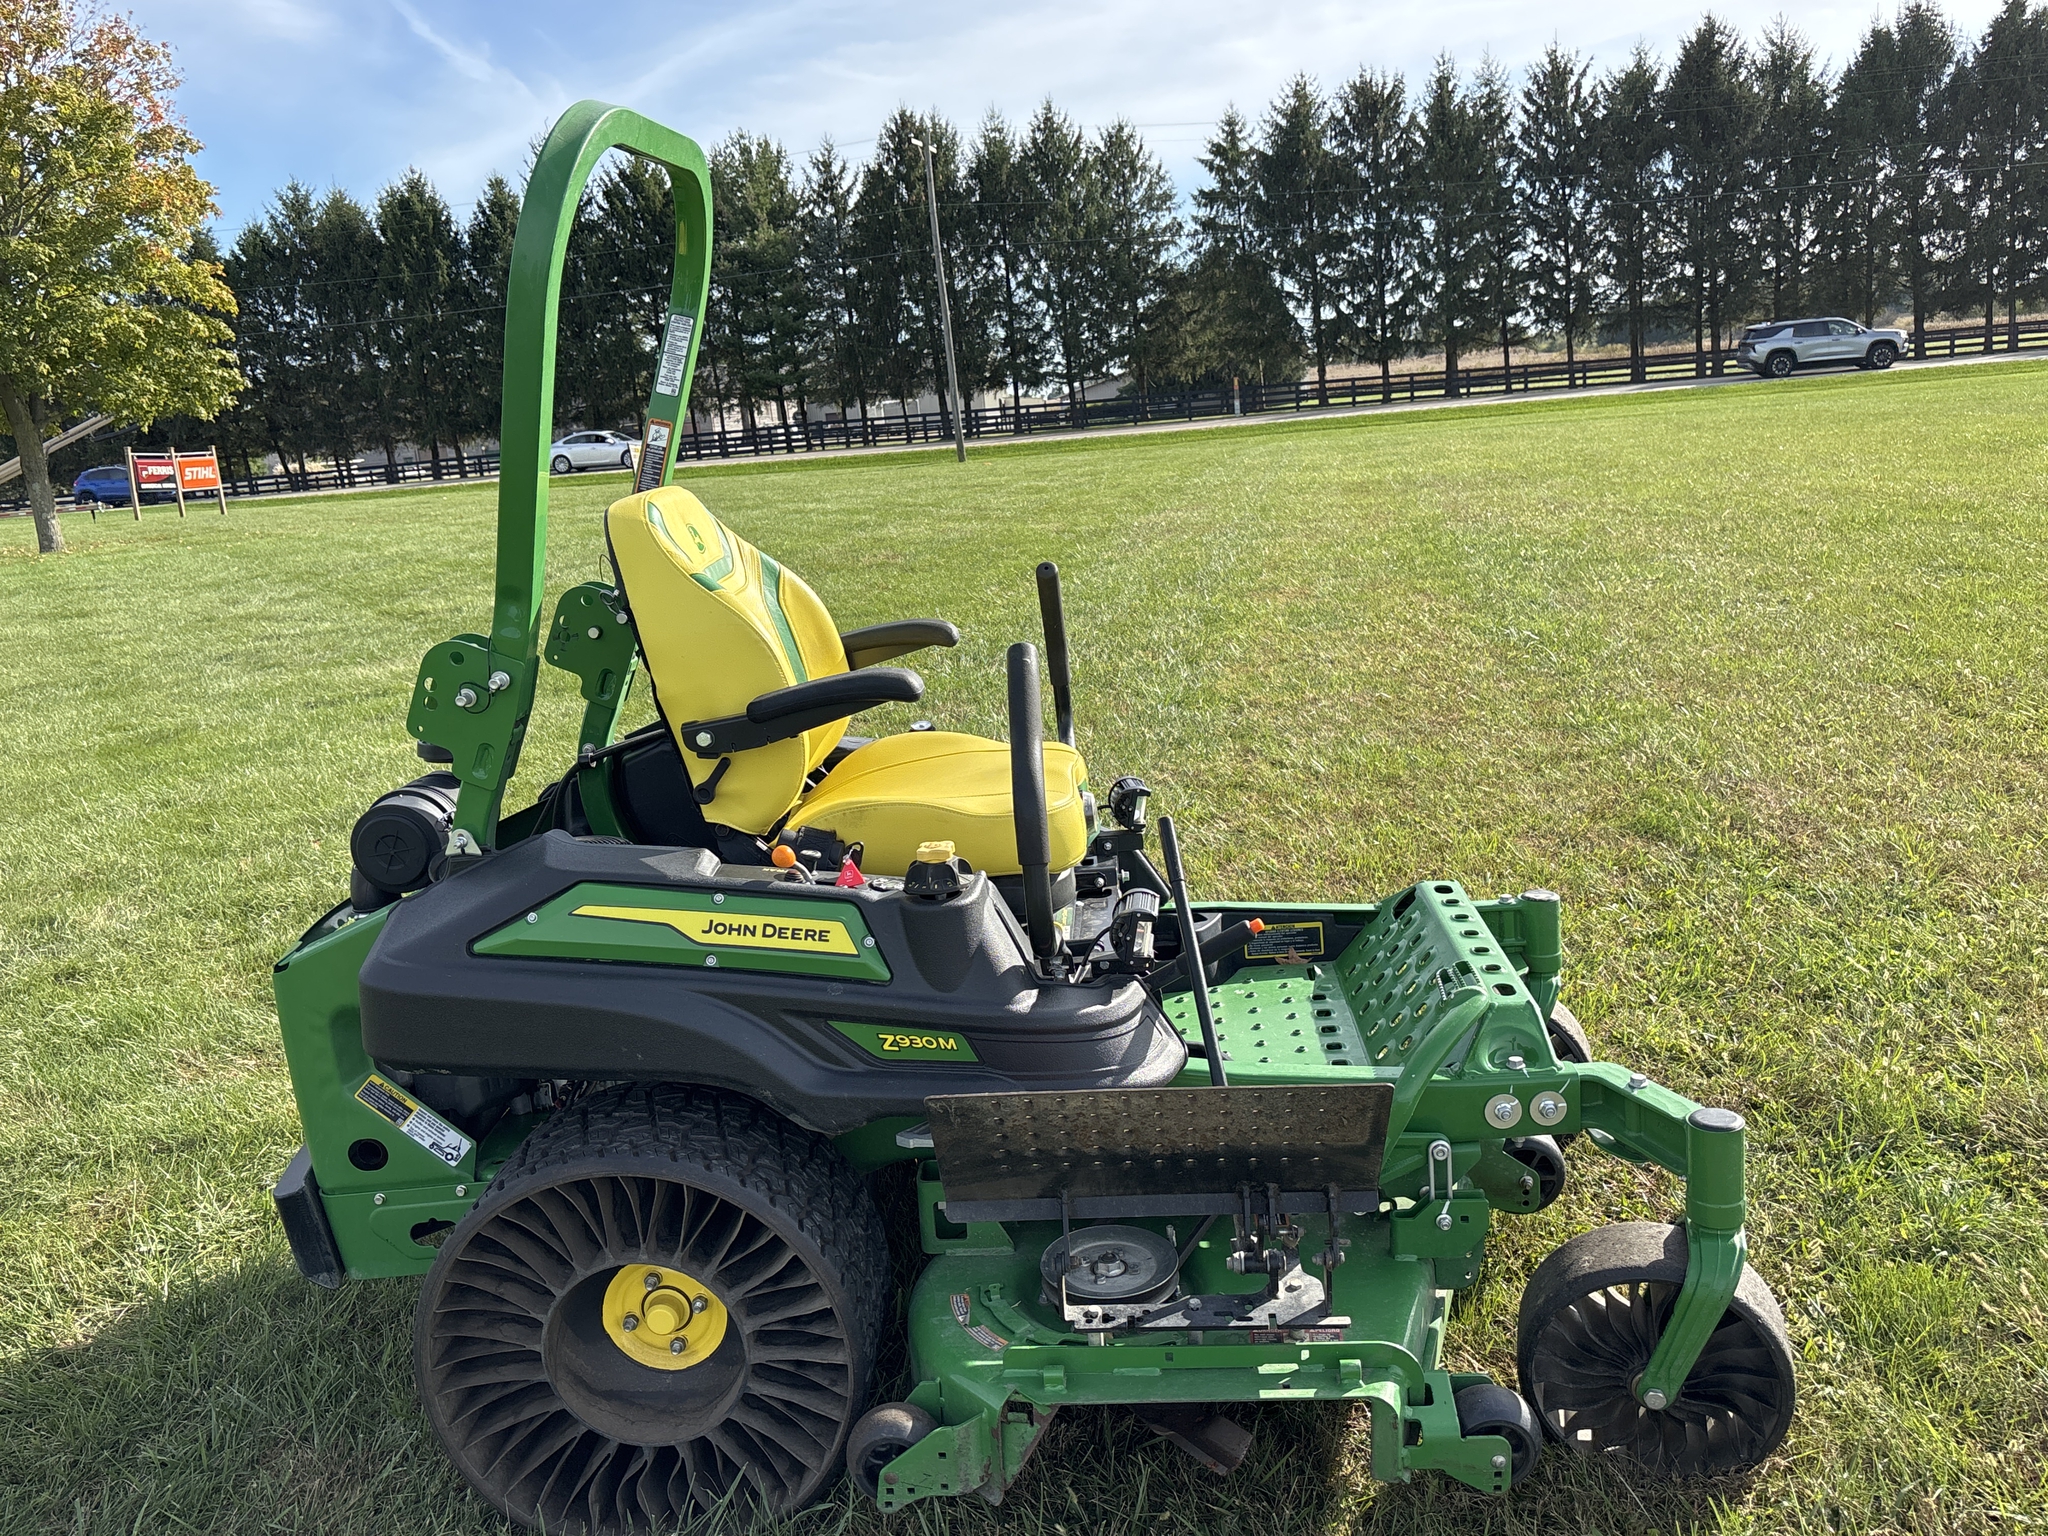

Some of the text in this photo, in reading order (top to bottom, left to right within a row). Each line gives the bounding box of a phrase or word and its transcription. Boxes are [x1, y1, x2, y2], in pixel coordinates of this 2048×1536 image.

[147, 466, 175, 476] FERRIS
[184, 466, 216, 481] STIHL
[701, 919, 831, 943] JOHN DEERE
[877, 1033, 958, 1051] Z930M
[384, 1084, 408, 1104] CAUTION
